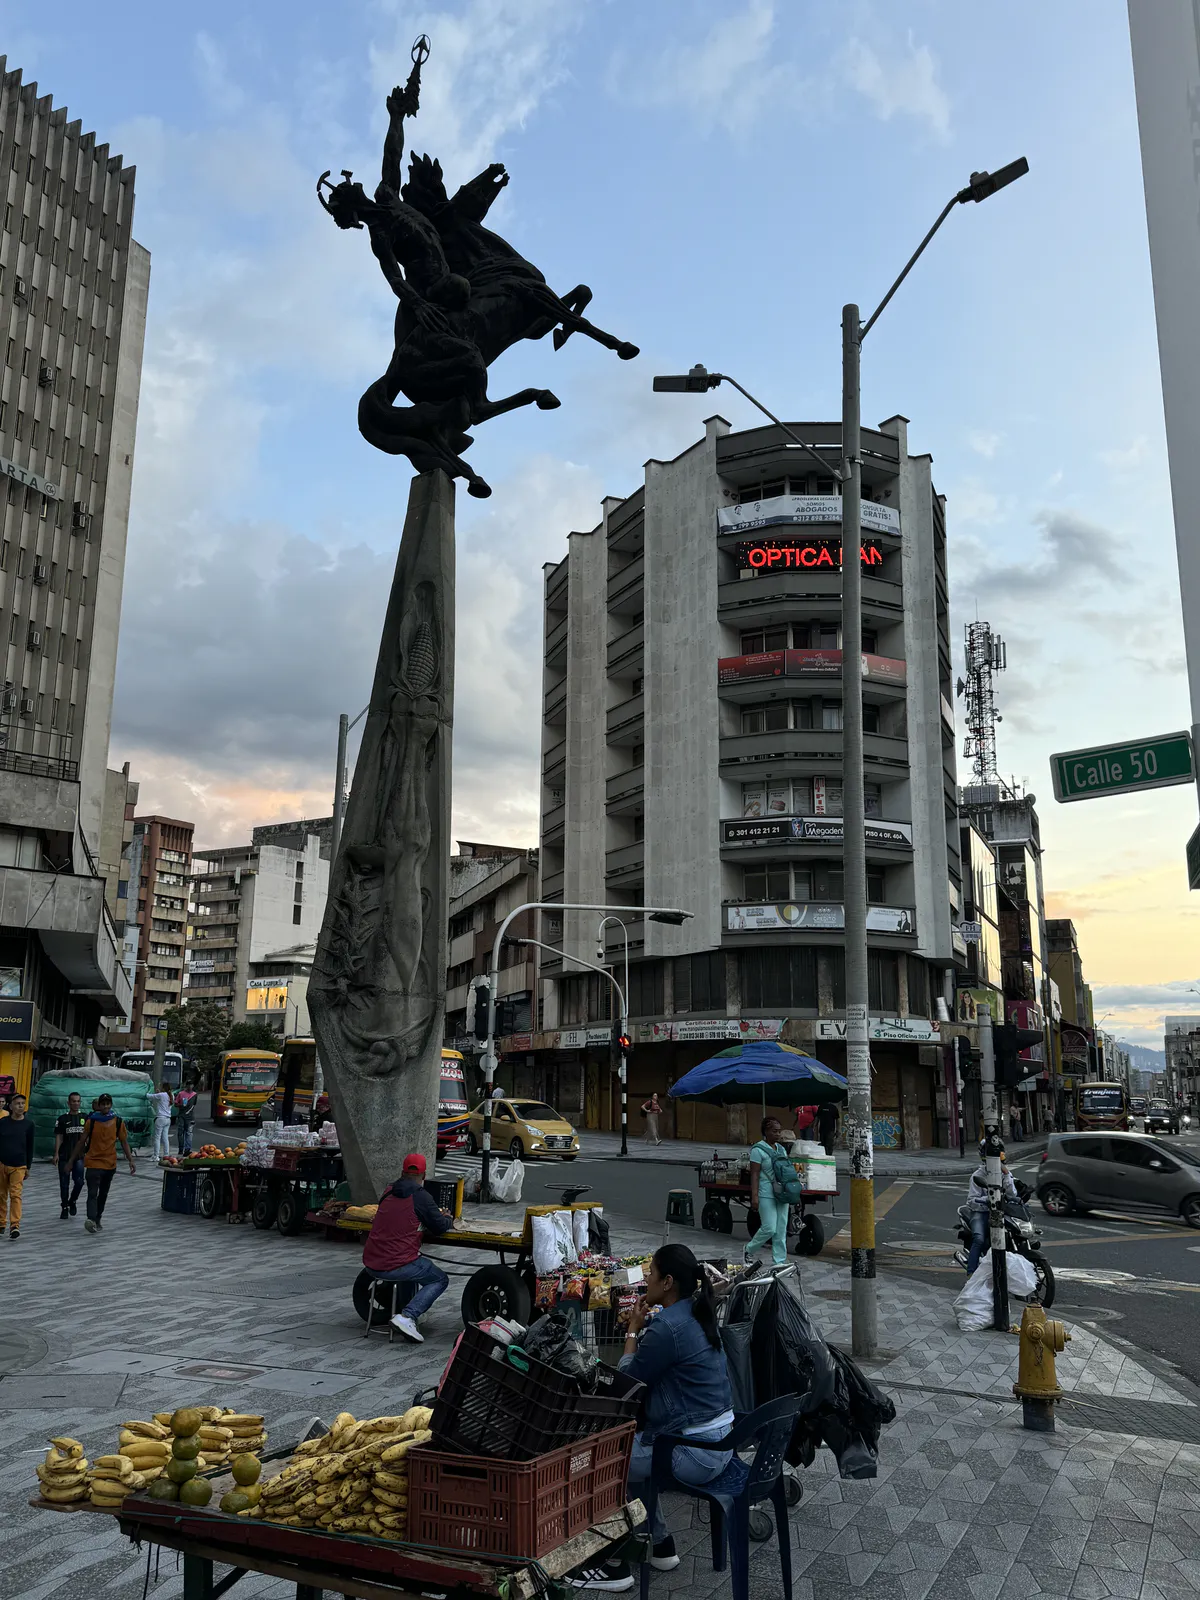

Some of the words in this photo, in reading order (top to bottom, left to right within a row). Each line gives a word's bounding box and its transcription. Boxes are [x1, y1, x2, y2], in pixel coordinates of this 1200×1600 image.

[863, 510, 892, 521] GRATIS!
[748, 547, 834, 567] OPTICA
[1074, 758, 1123, 788] Calle
[1130, 749, 1158, 778] 50
